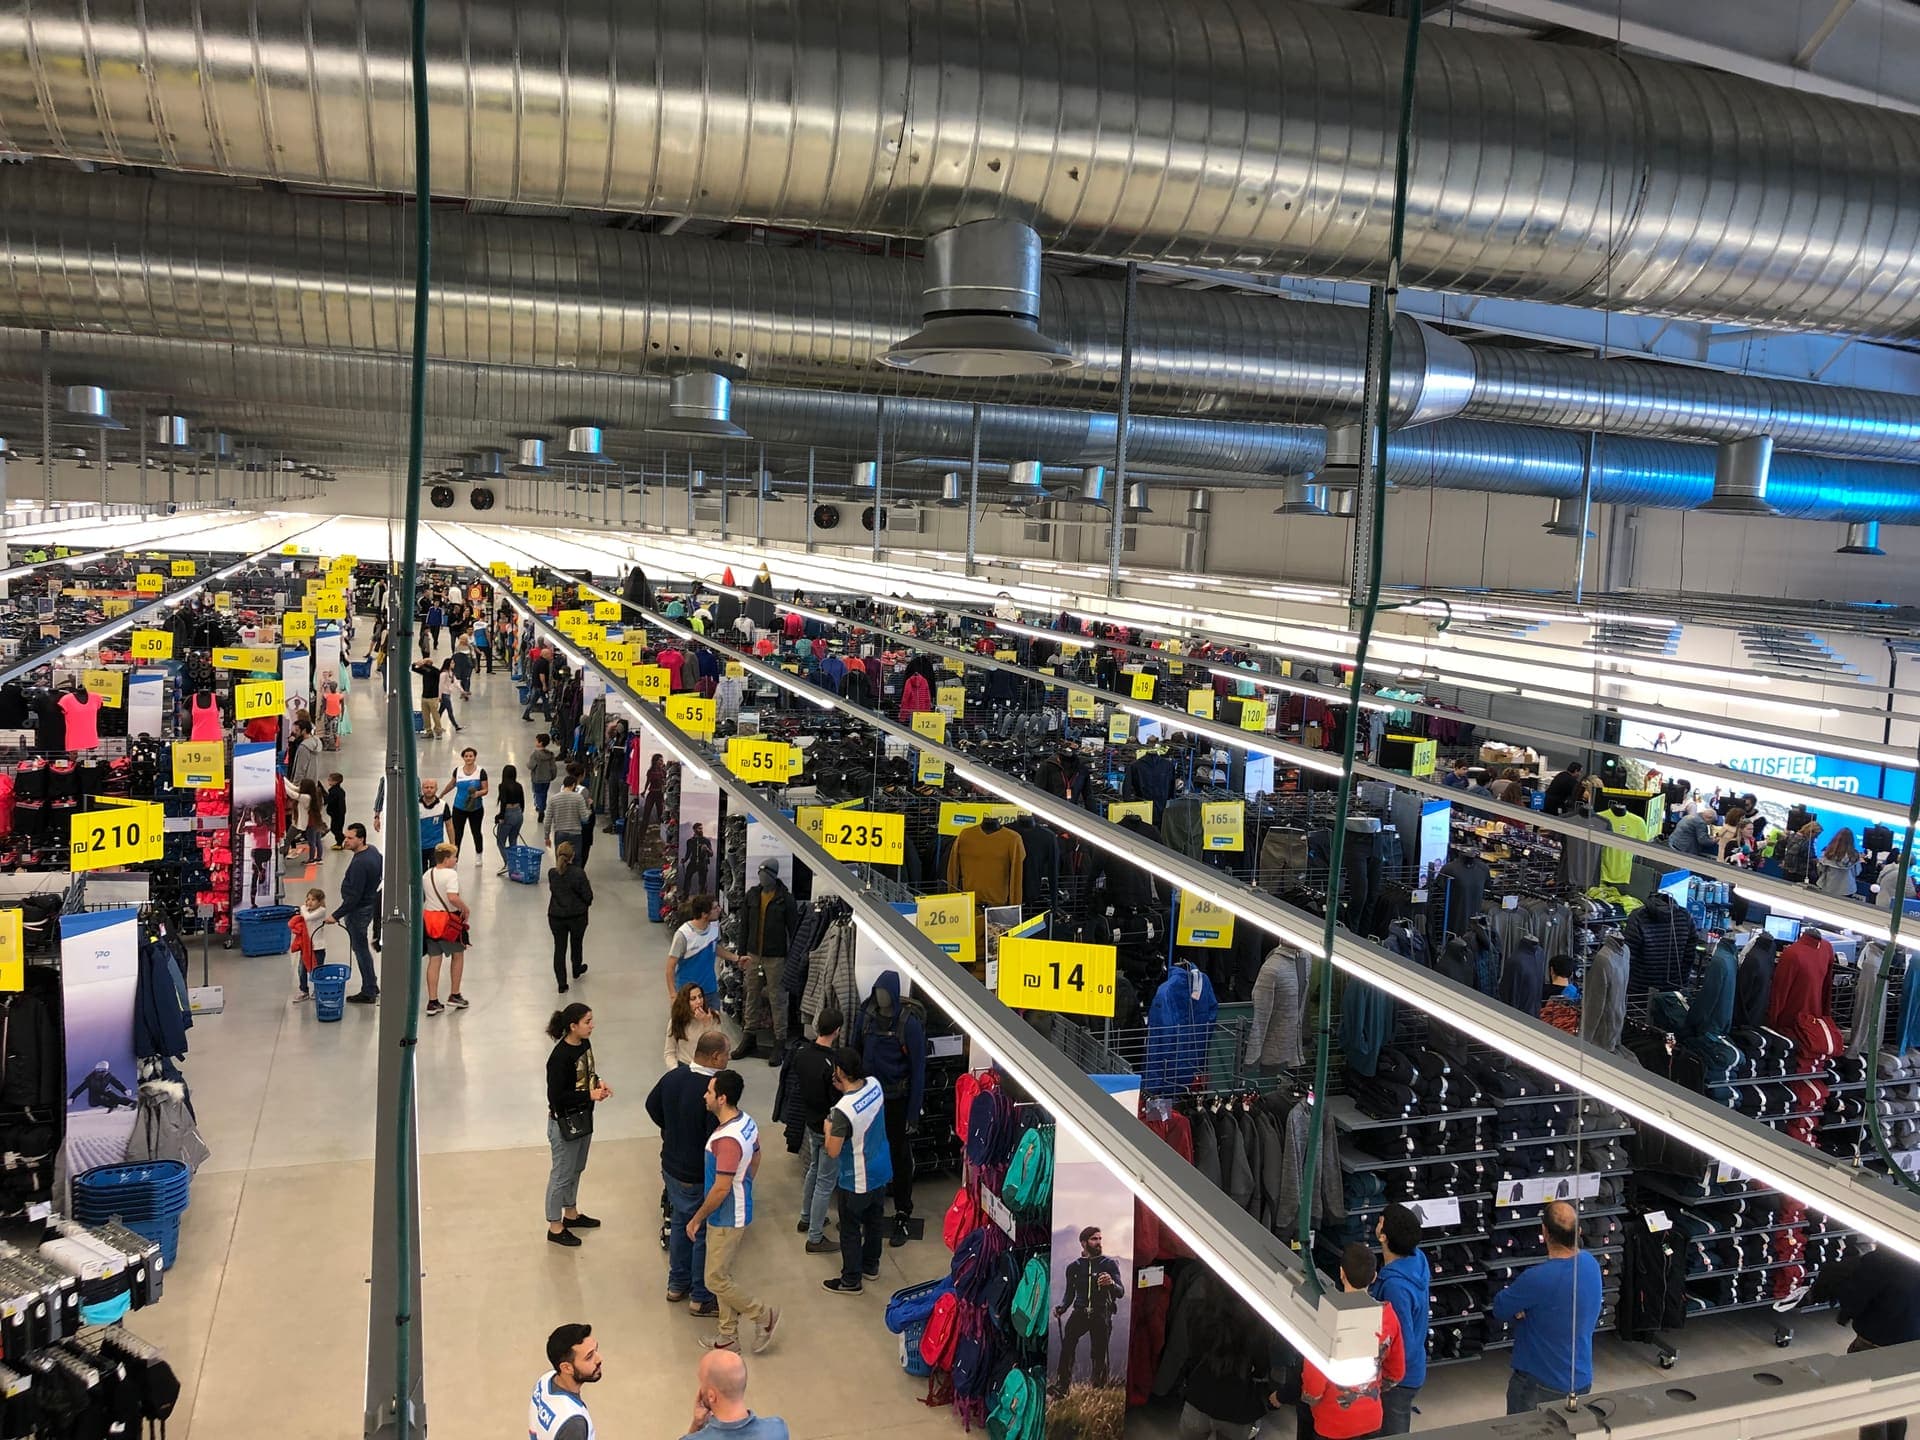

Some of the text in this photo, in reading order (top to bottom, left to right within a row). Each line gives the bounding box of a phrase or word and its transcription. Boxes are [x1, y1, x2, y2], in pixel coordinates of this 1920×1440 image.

[296, 620, 307, 630] 38
[570, 616, 581, 625] 38
[588, 632, 599, 641] 34
[148, 640, 162, 650] 50
[605, 650, 624, 662] 120
[644, 675, 660, 688] 38
[255, 692, 272, 707] 70
[686, 706, 703, 721] 55
[1248, 710, 1260, 722] 120
[752, 752, 773, 769] 55
[1729, 756, 1816, 776] SATISFIED
[92, 823, 140, 851] 210
[840, 824, 883, 847] 235
[1049, 962, 1084, 992] 14
